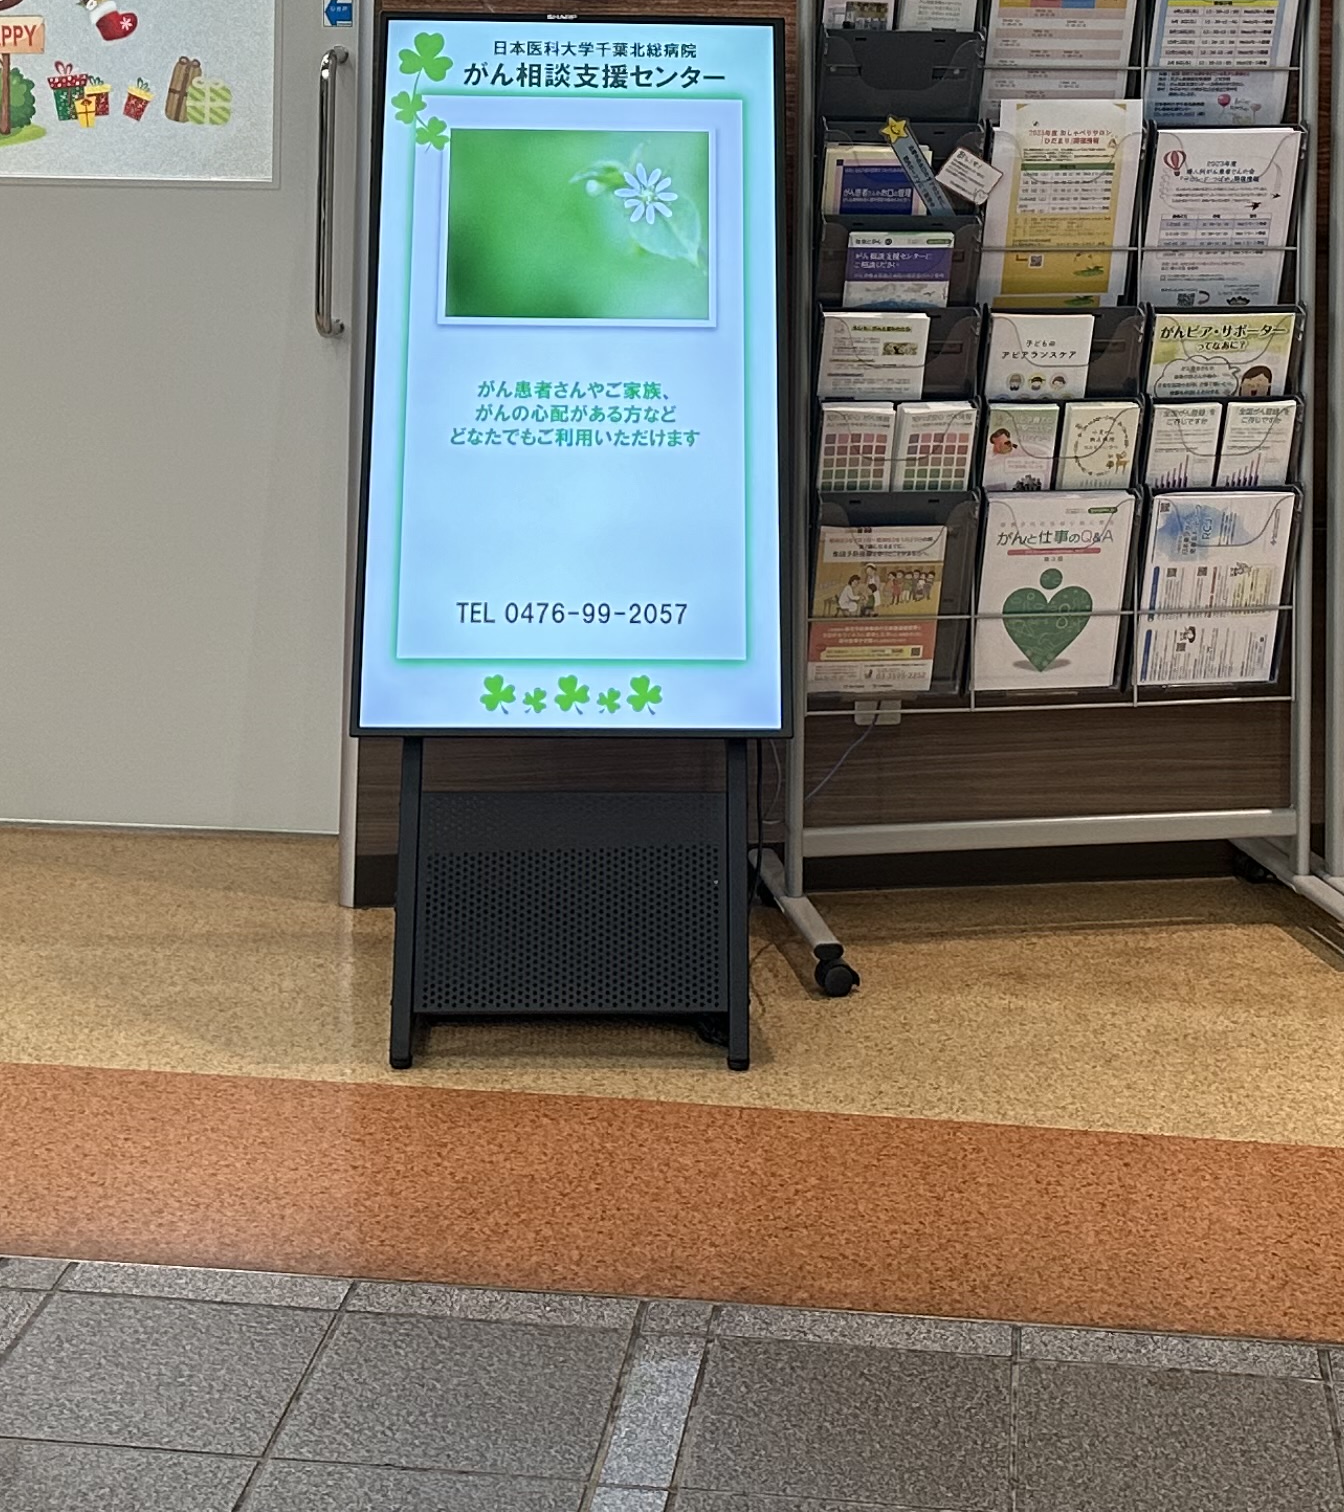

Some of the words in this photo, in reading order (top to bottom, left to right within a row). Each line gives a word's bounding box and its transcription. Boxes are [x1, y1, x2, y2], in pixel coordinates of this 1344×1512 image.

[493, 39, 698, 59] 日本医科大学千葉北総病院
[463, 63, 726, 91] がん相談支援センター
[1159, 325, 1289, 340] がんピア・サポーター
[476, 379, 672, 401] がん患者さんやご家族、
[474, 402, 678, 425] がんの心配がある方など
[449, 425, 701, 449] どなたでもご利用いただけます
[996, 529, 1114, 546] がんと仕事のQ&A
[456, 601, 496, 626] TEL
[505, 602, 689, 627] 0476-99-2057
